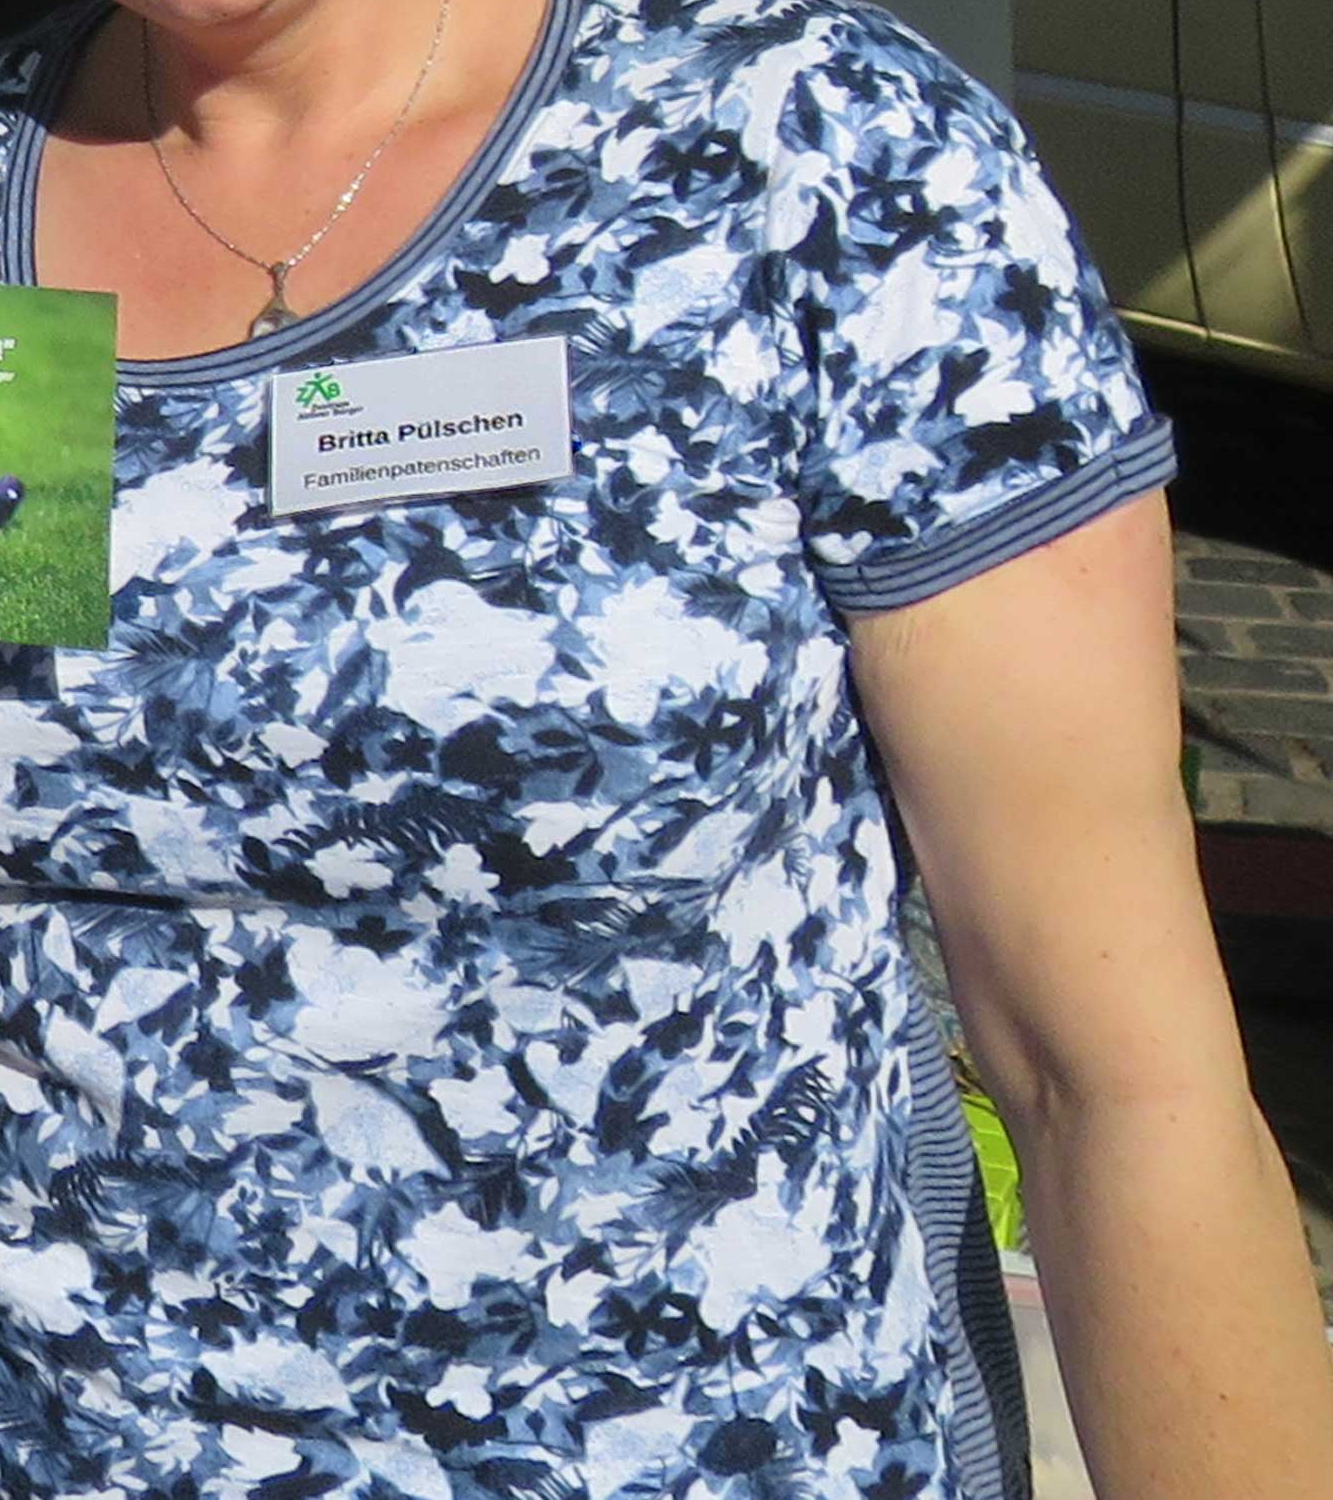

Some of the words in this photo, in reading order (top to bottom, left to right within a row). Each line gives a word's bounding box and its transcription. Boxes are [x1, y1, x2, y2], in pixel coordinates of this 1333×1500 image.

[318, 429, 390, 453] Britta
[398, 410, 524, 442] Pülschen
[303, 446, 542, 490] Familienpatenschaften
